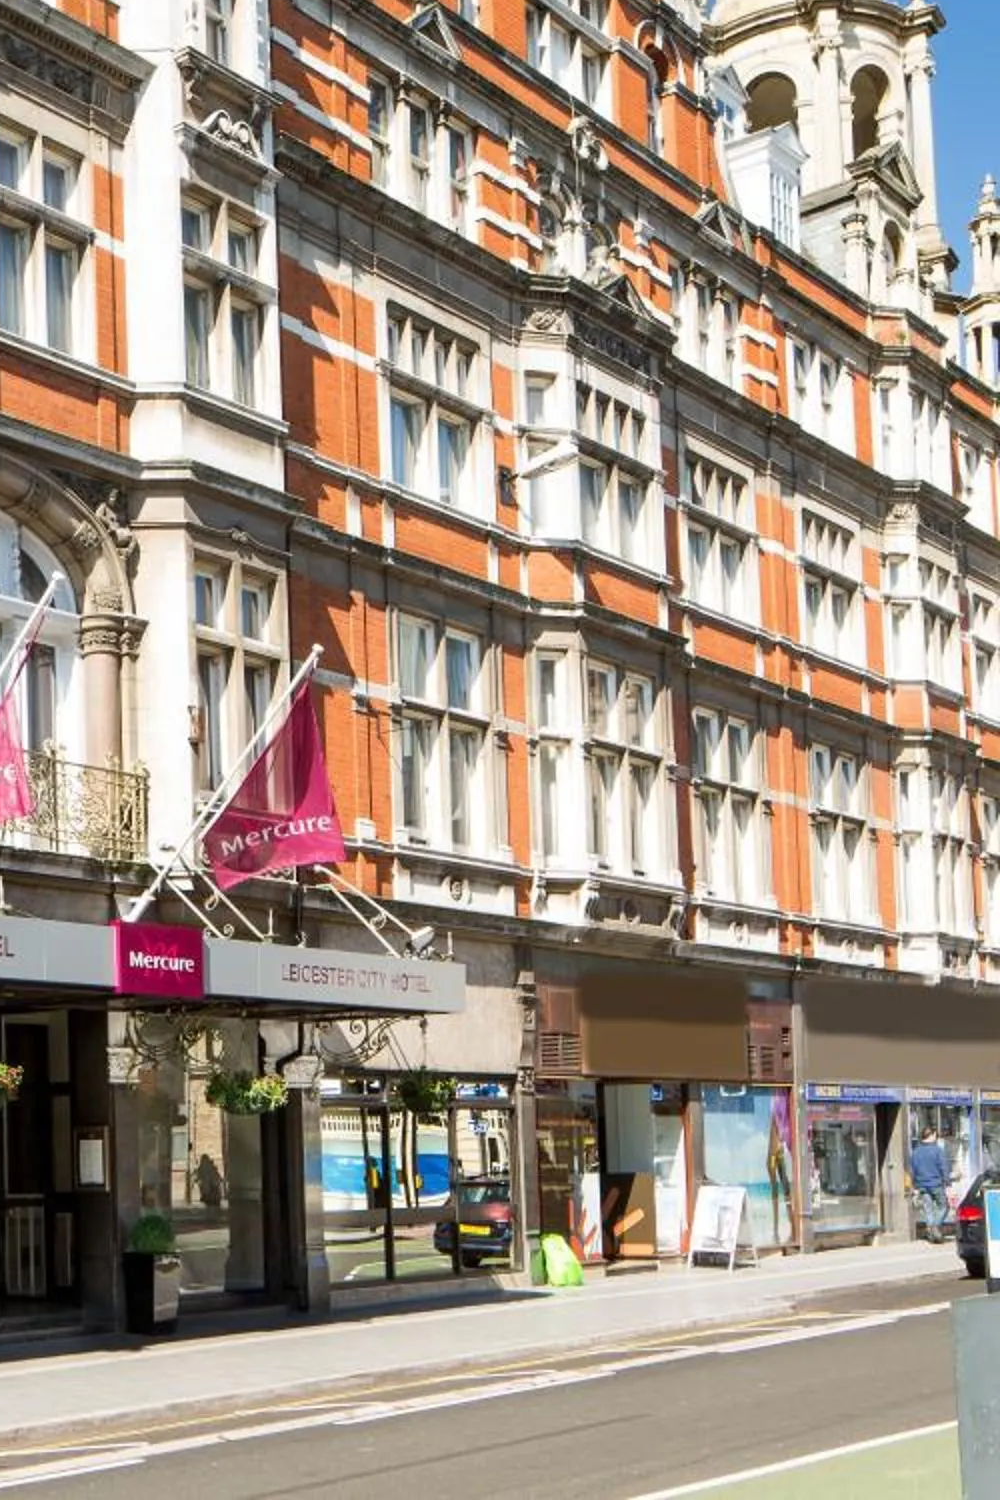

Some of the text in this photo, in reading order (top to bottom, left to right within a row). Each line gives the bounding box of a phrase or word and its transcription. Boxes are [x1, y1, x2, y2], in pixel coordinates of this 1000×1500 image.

[220, 815, 332, 857] Mercure
[129, 950, 195, 973] Mercure
[281, 963, 355, 988] LEICESTER
